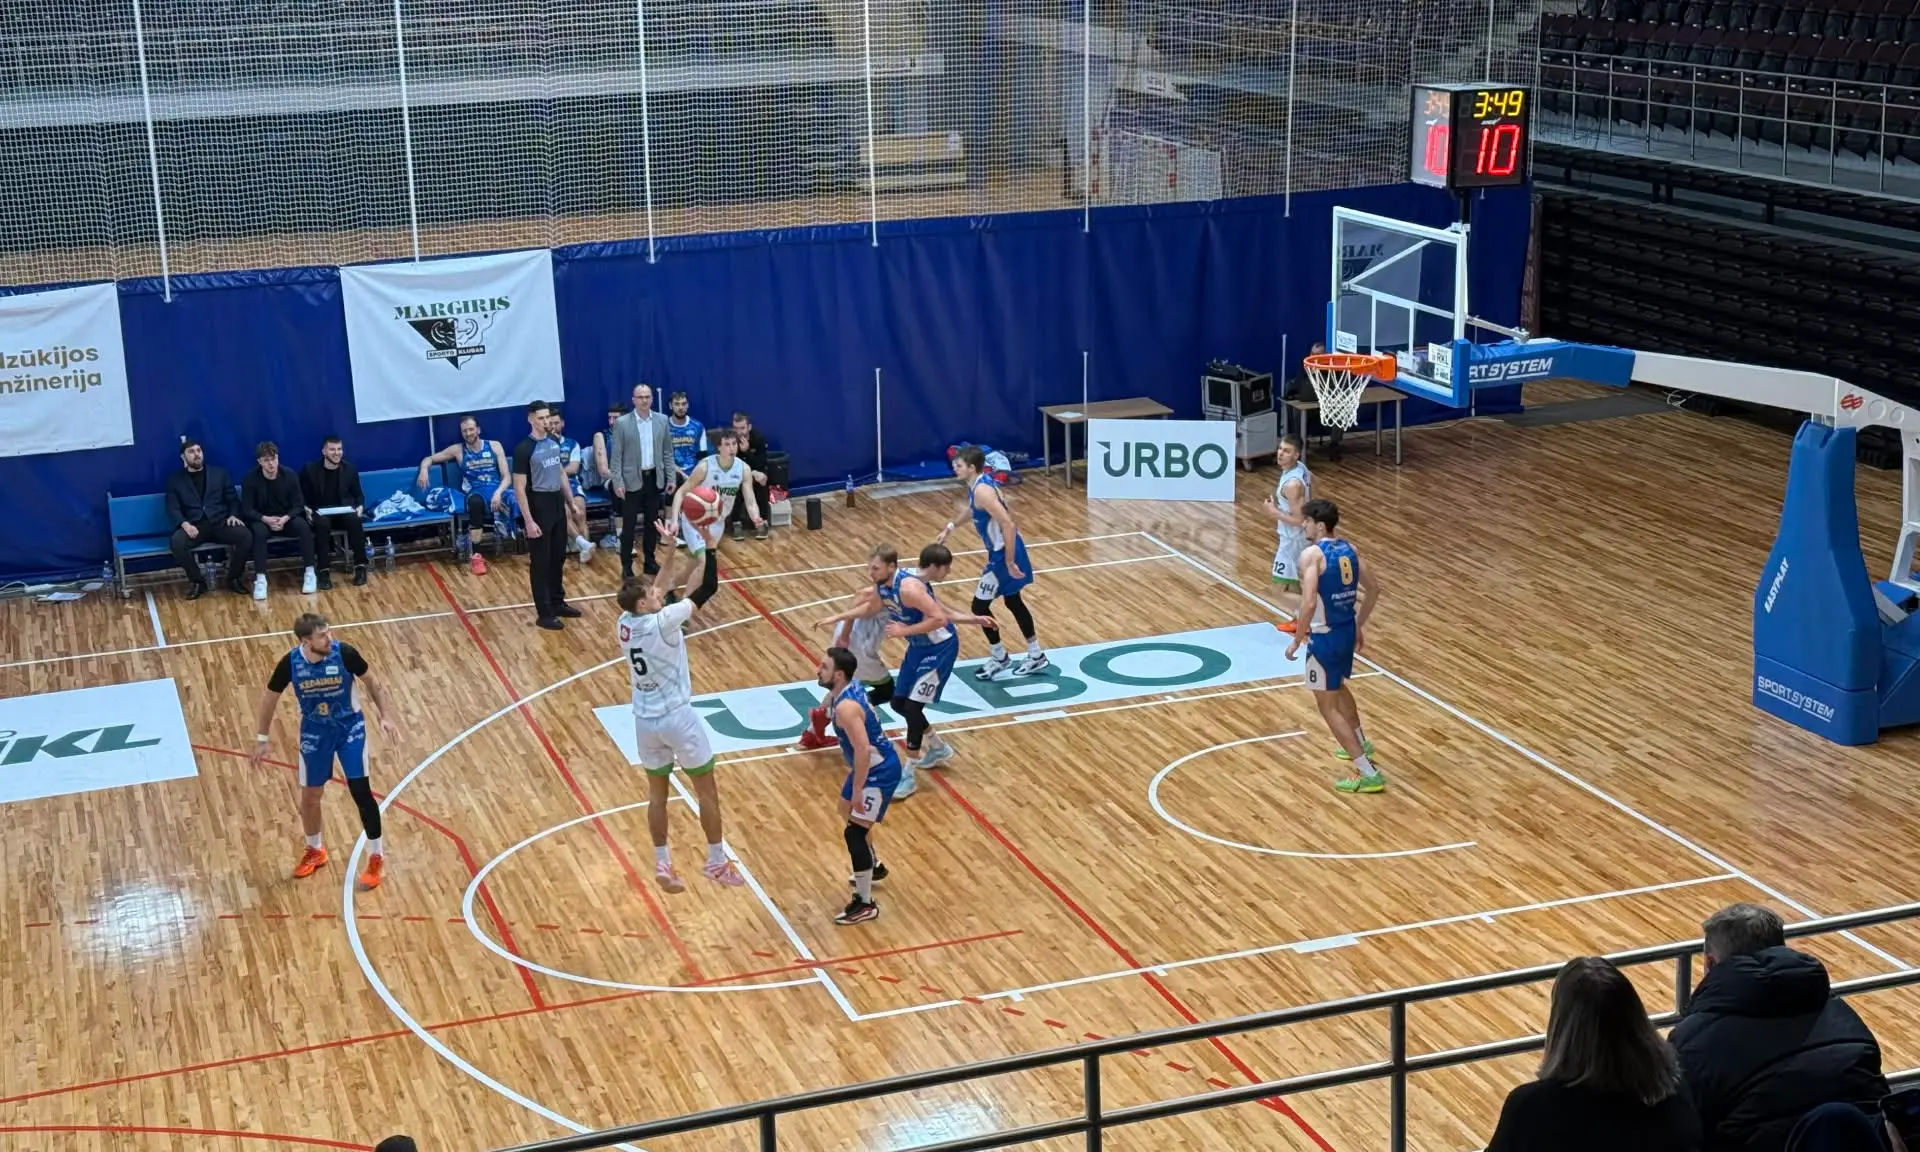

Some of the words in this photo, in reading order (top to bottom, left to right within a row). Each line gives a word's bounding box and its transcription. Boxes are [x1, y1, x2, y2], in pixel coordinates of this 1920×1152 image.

[1474, 90, 1523, 118] 3:49
[1475, 124, 1520, 176] 10
[393, 296, 511, 320] MARGIRIS
[1096, 441, 1229, 480] URBO
[1273, 560, 1286, 575] 12
[1338, 555, 1354, 586] 8
[979, 582, 995, 595] 44
[1764, 556, 1790, 614] EASYPLAY
[629, 647, 648, 676] 5
[917, 681, 936, 697] 30
[1309, 669, 1317, 683] 8
[863, 796, 875, 813] 5
